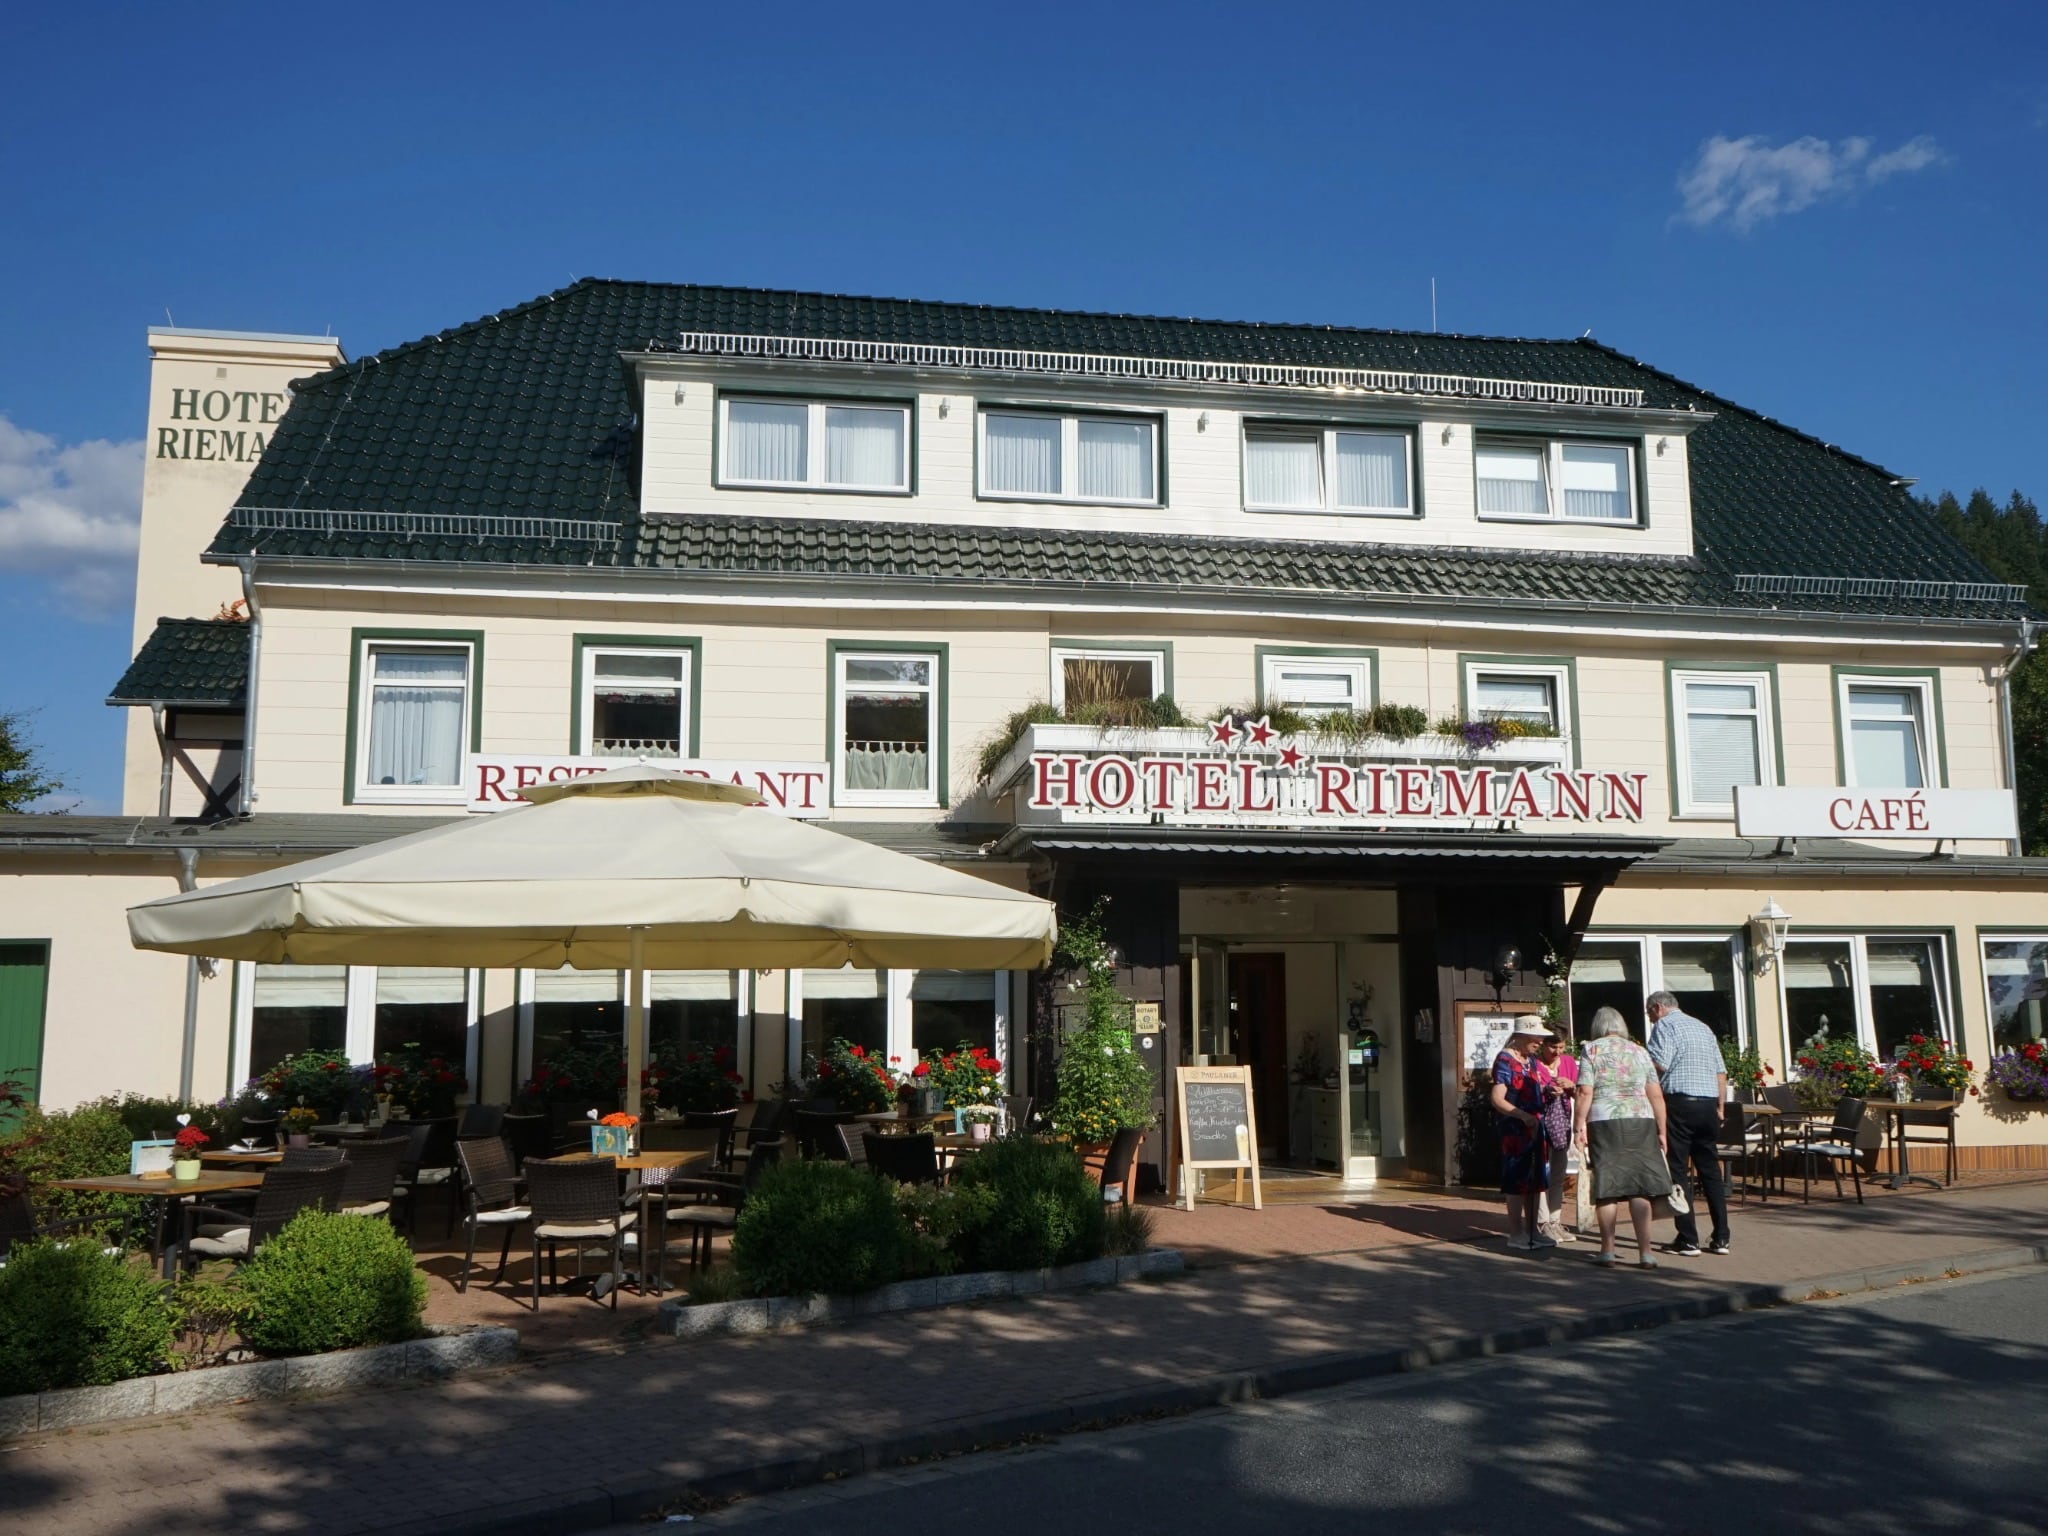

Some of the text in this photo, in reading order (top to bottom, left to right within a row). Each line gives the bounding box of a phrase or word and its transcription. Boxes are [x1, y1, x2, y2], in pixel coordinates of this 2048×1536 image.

[170, 388, 284, 424] HOTE
[156, 427, 268, 463] RIEMA
[1033, 757, 1648, 820] HOTEL RIEMANN
[1829, 790, 1930, 831] CAFÉ
